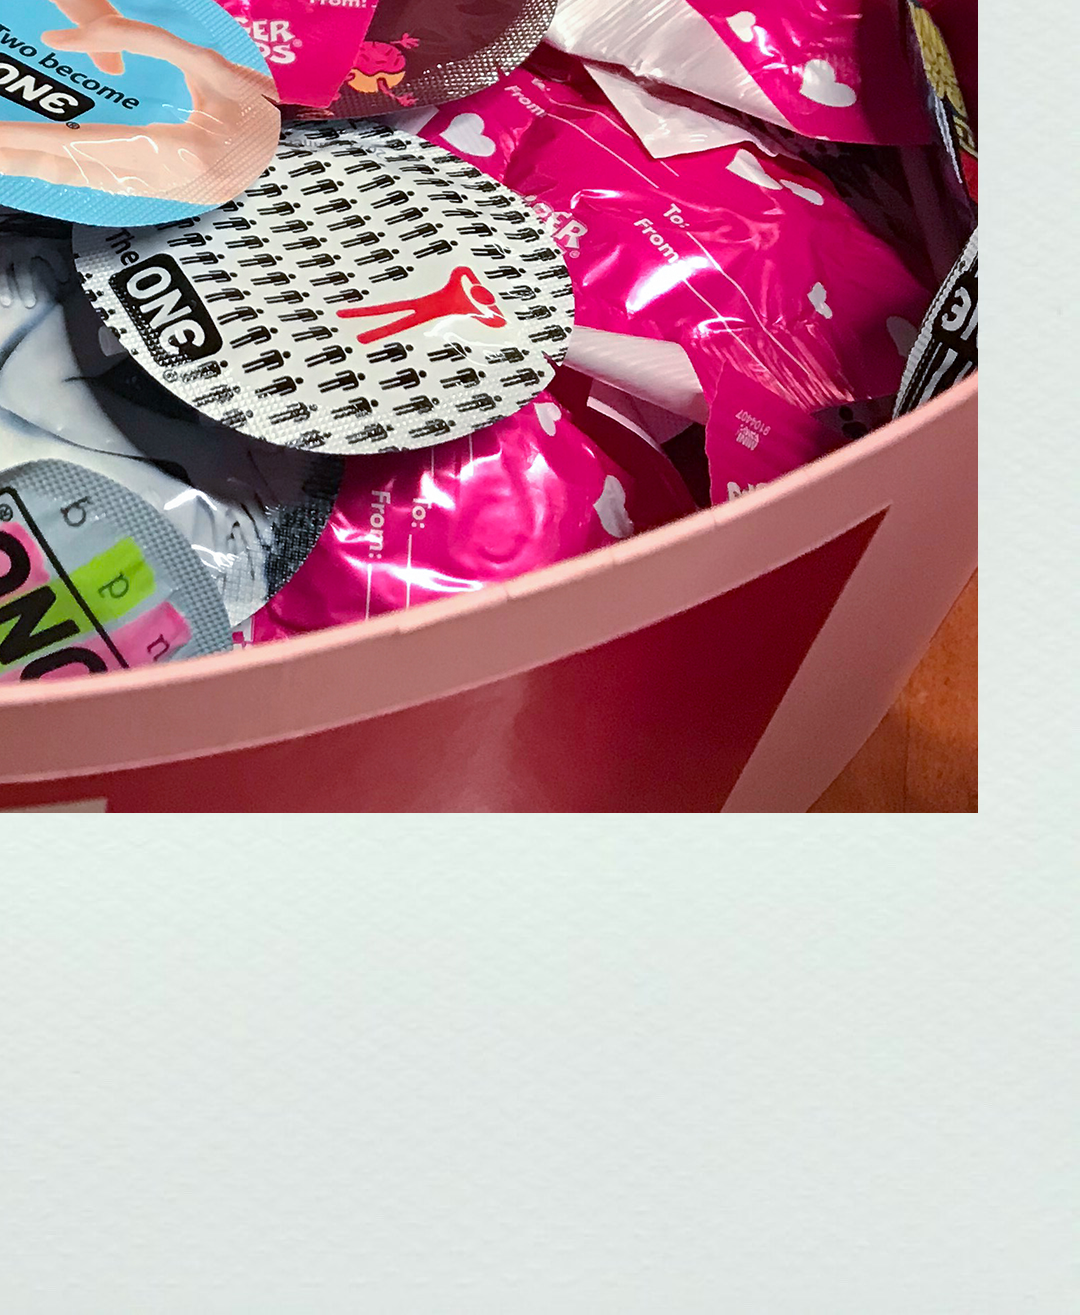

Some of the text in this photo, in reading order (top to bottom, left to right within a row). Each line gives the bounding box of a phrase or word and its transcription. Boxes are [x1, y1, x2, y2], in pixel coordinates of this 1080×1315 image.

[38, 52, 140, 110] become
[663, 203, 690, 229] To:
[105, 228, 140, 266] The
[126, 266, 206, 355] ONE
[370, 490, 391, 559] From:
